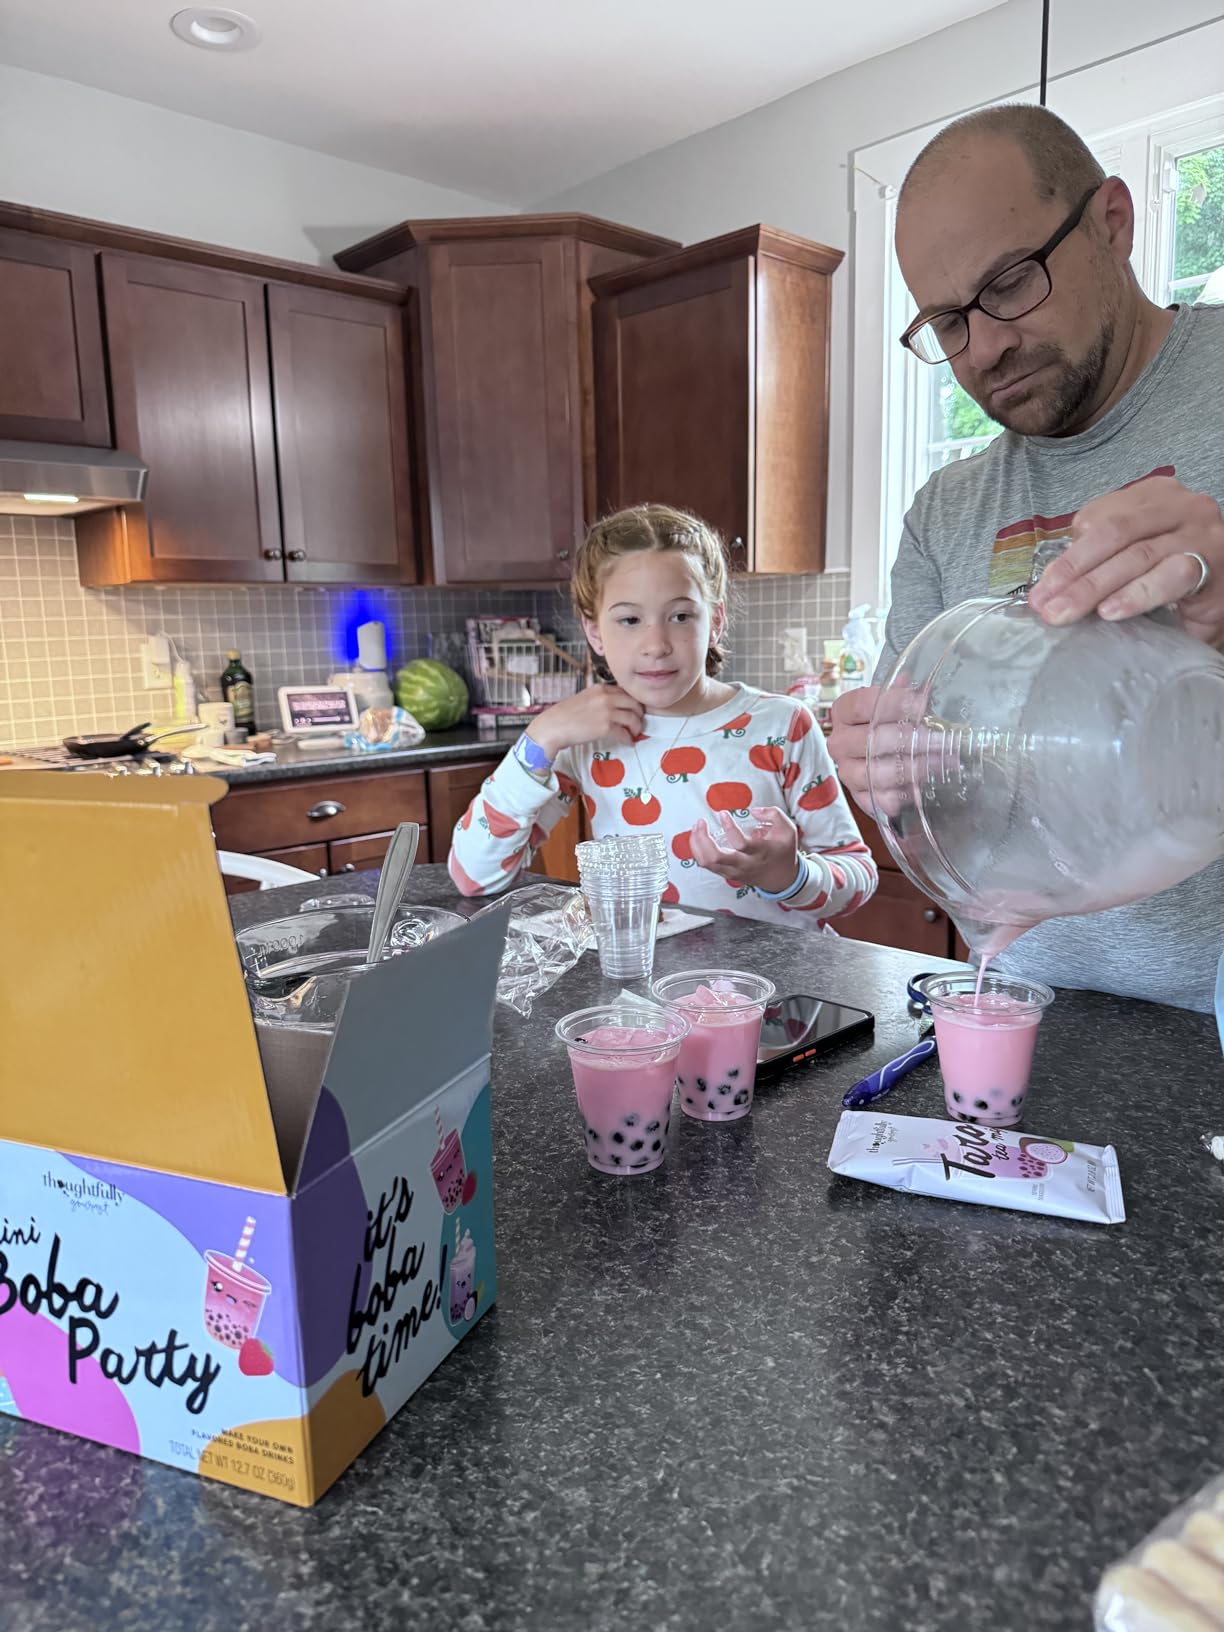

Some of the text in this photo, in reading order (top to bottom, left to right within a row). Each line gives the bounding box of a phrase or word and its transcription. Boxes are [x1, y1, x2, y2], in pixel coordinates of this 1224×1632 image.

[940, 1124, 996, 1181] Taro
[992, 1143, 1010, 1161] tea
[43, 1171, 122, 1206] thoughtfully
[0, 1216, 41, 1246] ini
[363, 1176, 414, 1263] it's
[346, 1224, 425, 1355] boba
[355, 1244, 448, 1398] time!
[68, 1314, 222, 1415] Party
[169, 1439, 196, 1460] TOTAL
[216, 1453, 229, 1469] WT
[253, 1464, 265, 1481] OZ
[221, 1428, 294, 1454] MAKE YOUR OWN
[236, 1441, 259, 1456] BOBA
[262, 1449, 295, 1465] DRINKS
